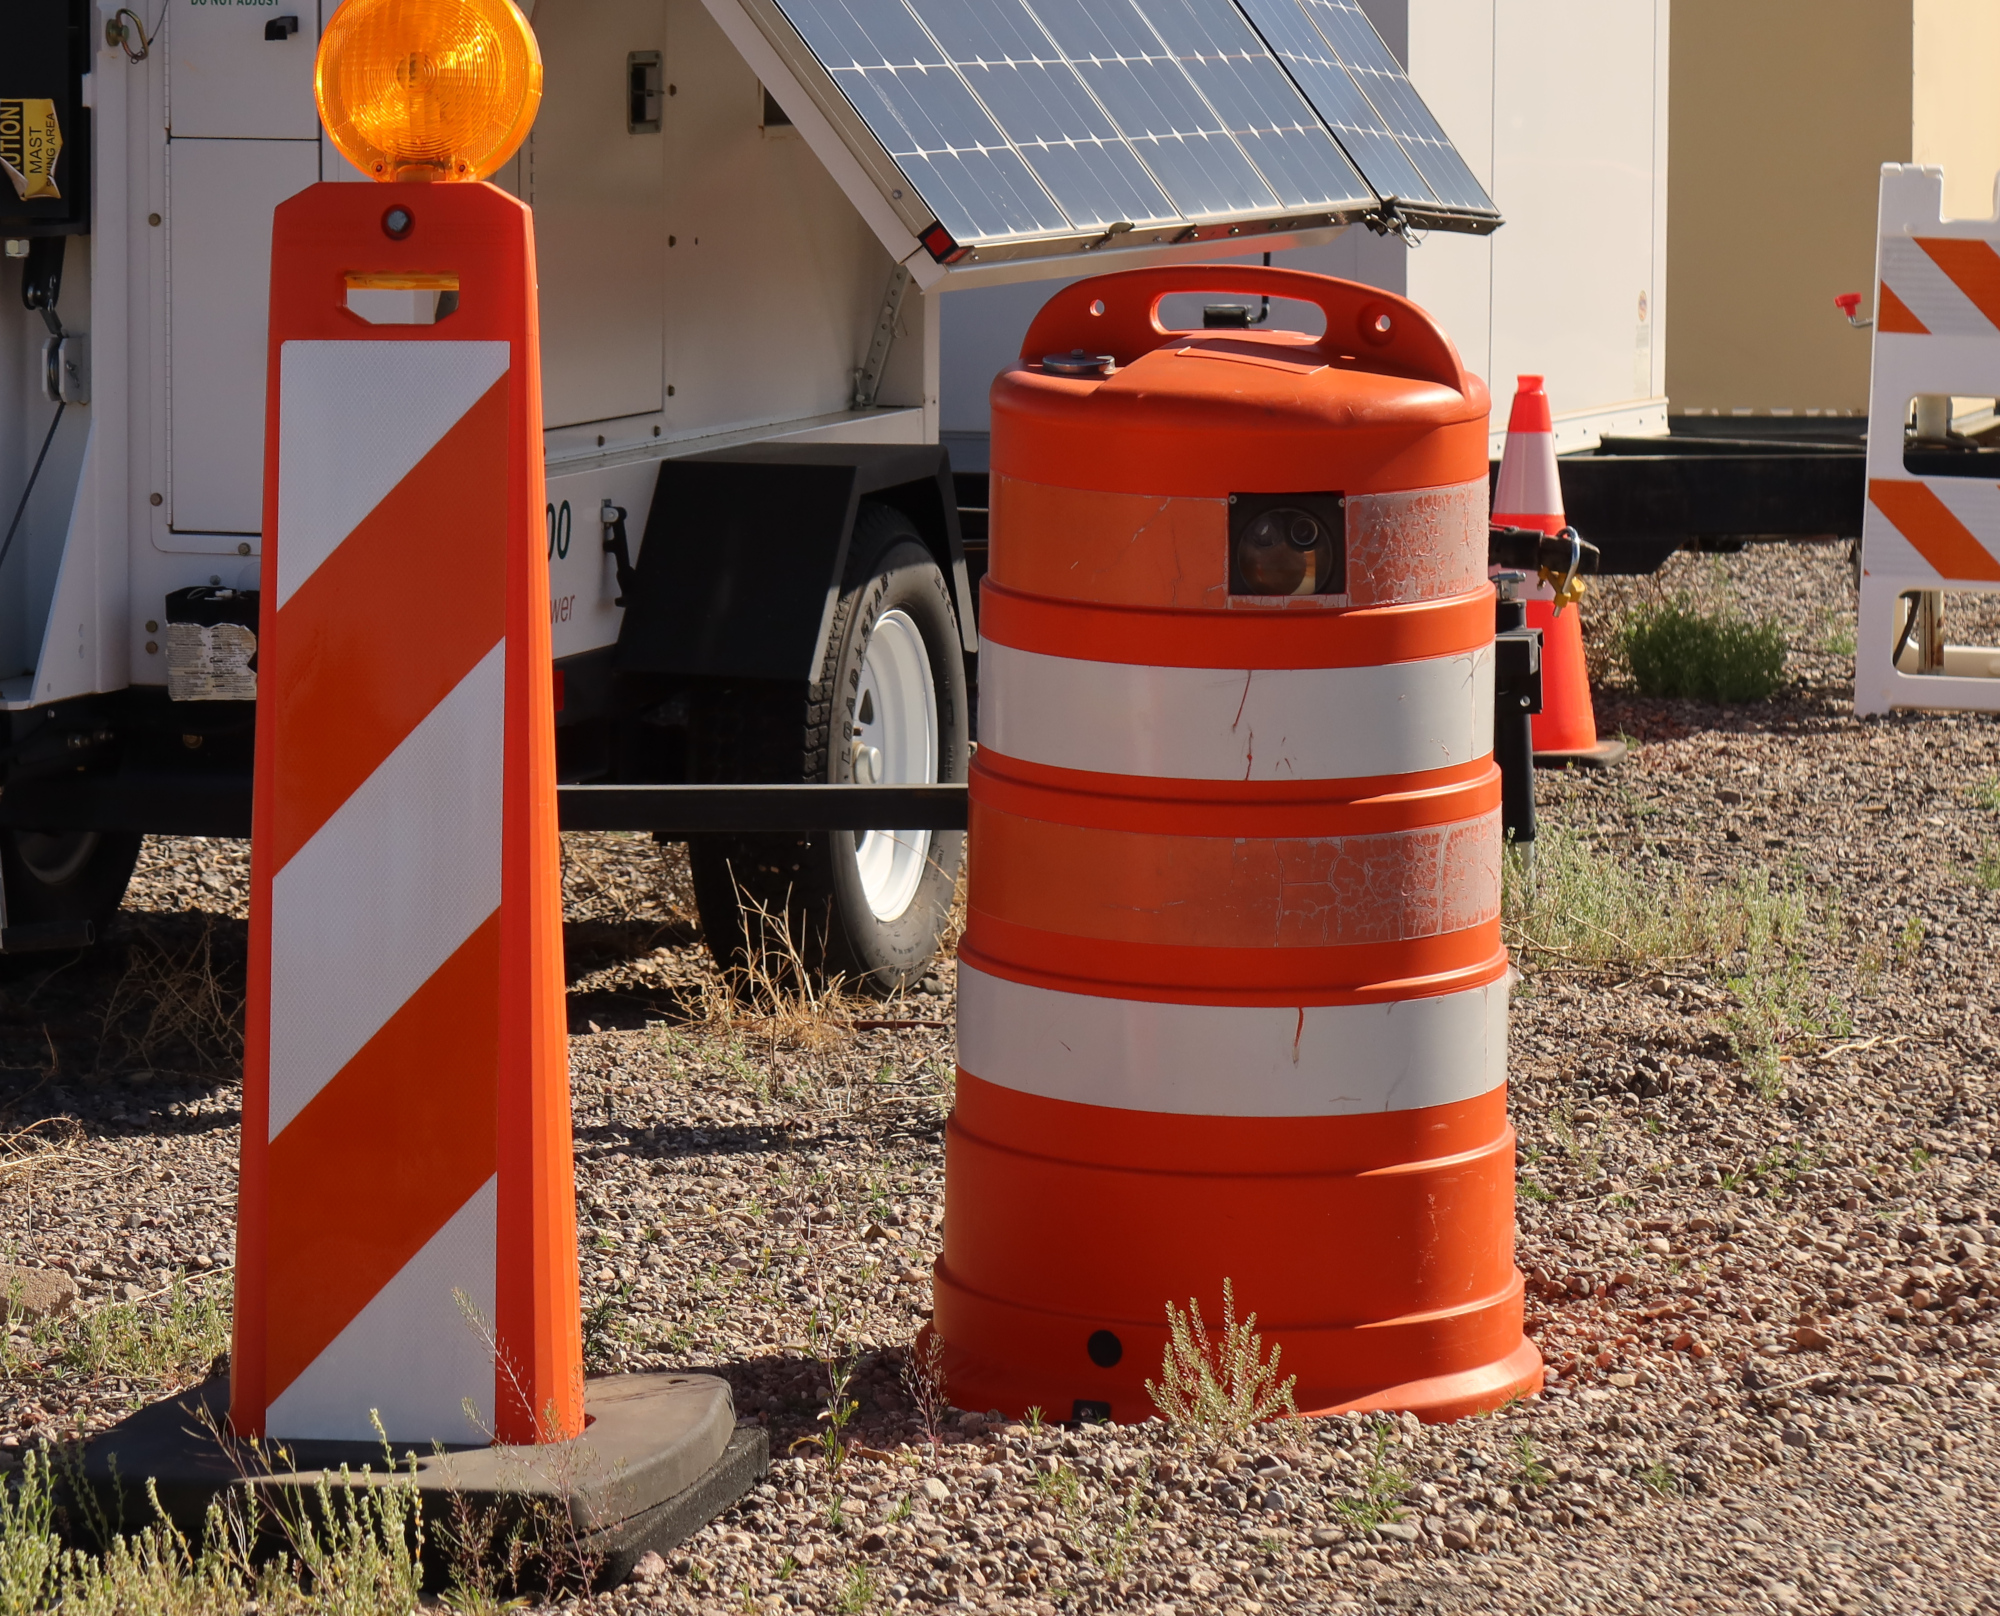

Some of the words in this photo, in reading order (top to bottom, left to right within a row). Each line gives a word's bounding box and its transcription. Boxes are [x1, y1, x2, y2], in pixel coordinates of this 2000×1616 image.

[0, 106, 20, 171] UTION
[29, 126, 42, 174] MAST
[46, 112, 55, 146] AREA
